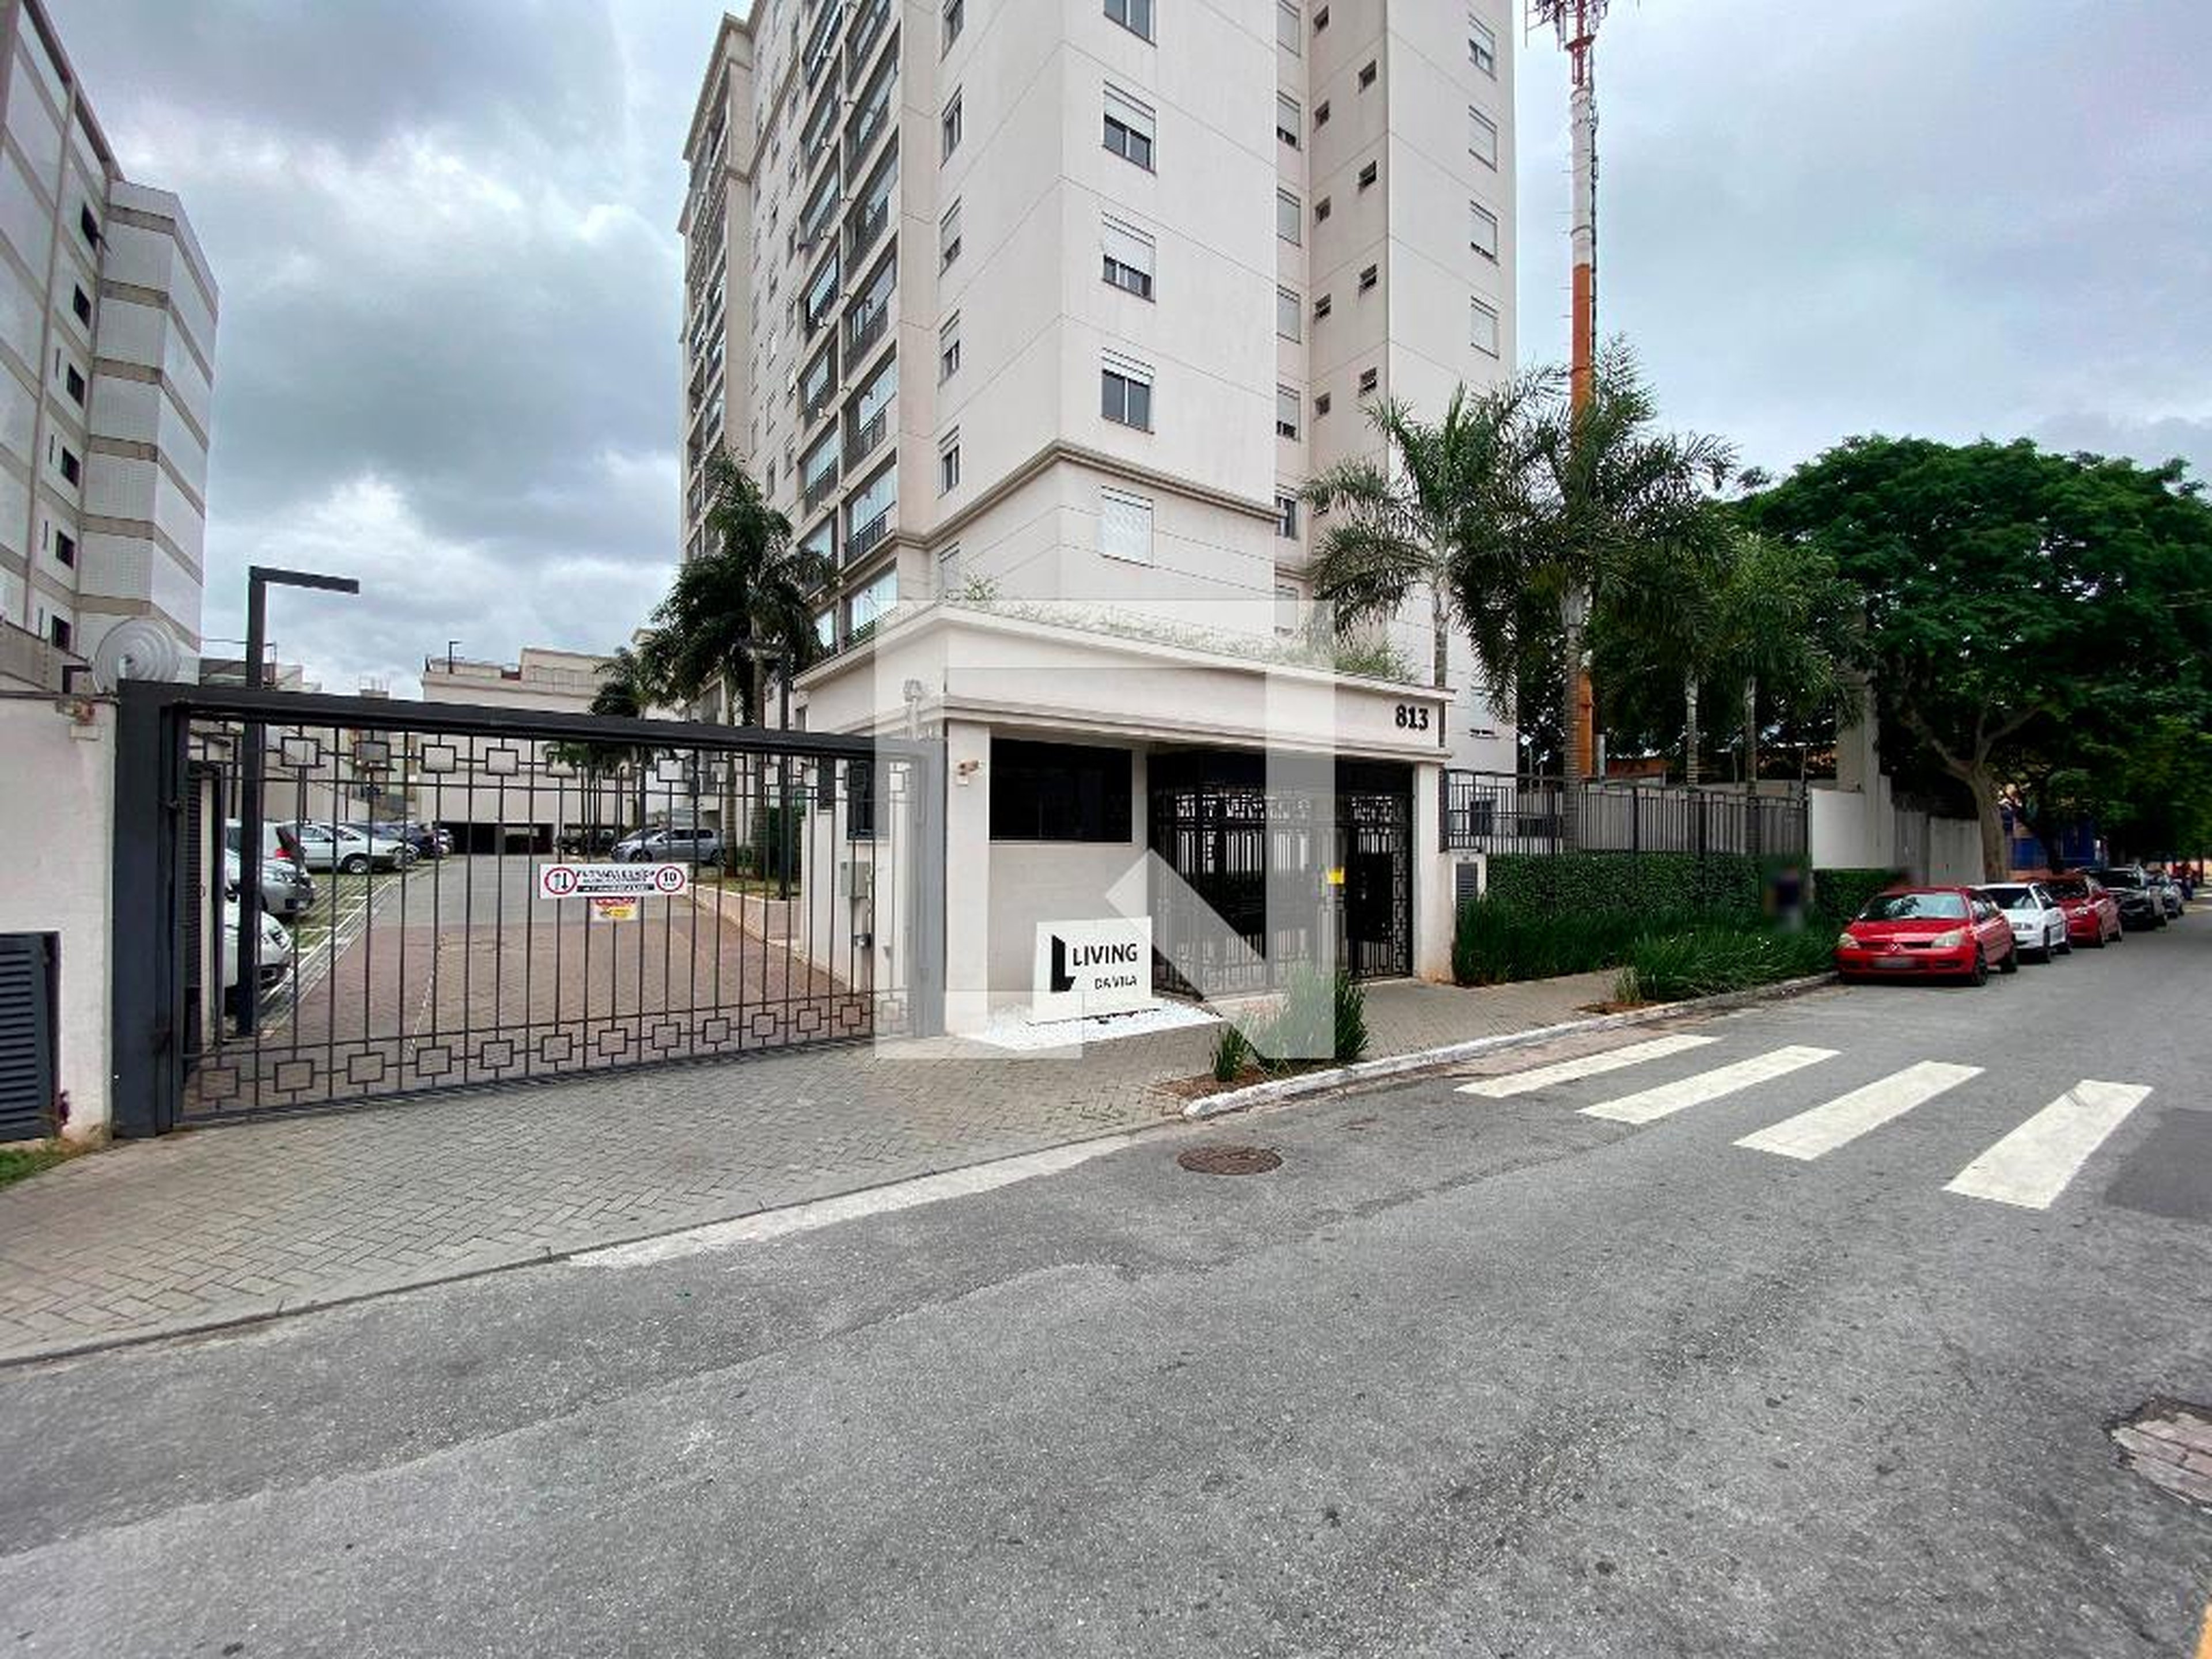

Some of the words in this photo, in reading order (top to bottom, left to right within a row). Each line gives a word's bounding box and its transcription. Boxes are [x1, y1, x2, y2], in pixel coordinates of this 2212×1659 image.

[1396, 704, 1429, 730] 813
[664, 872, 677, 882] 10
[1073, 943, 1138, 967] LIVING
